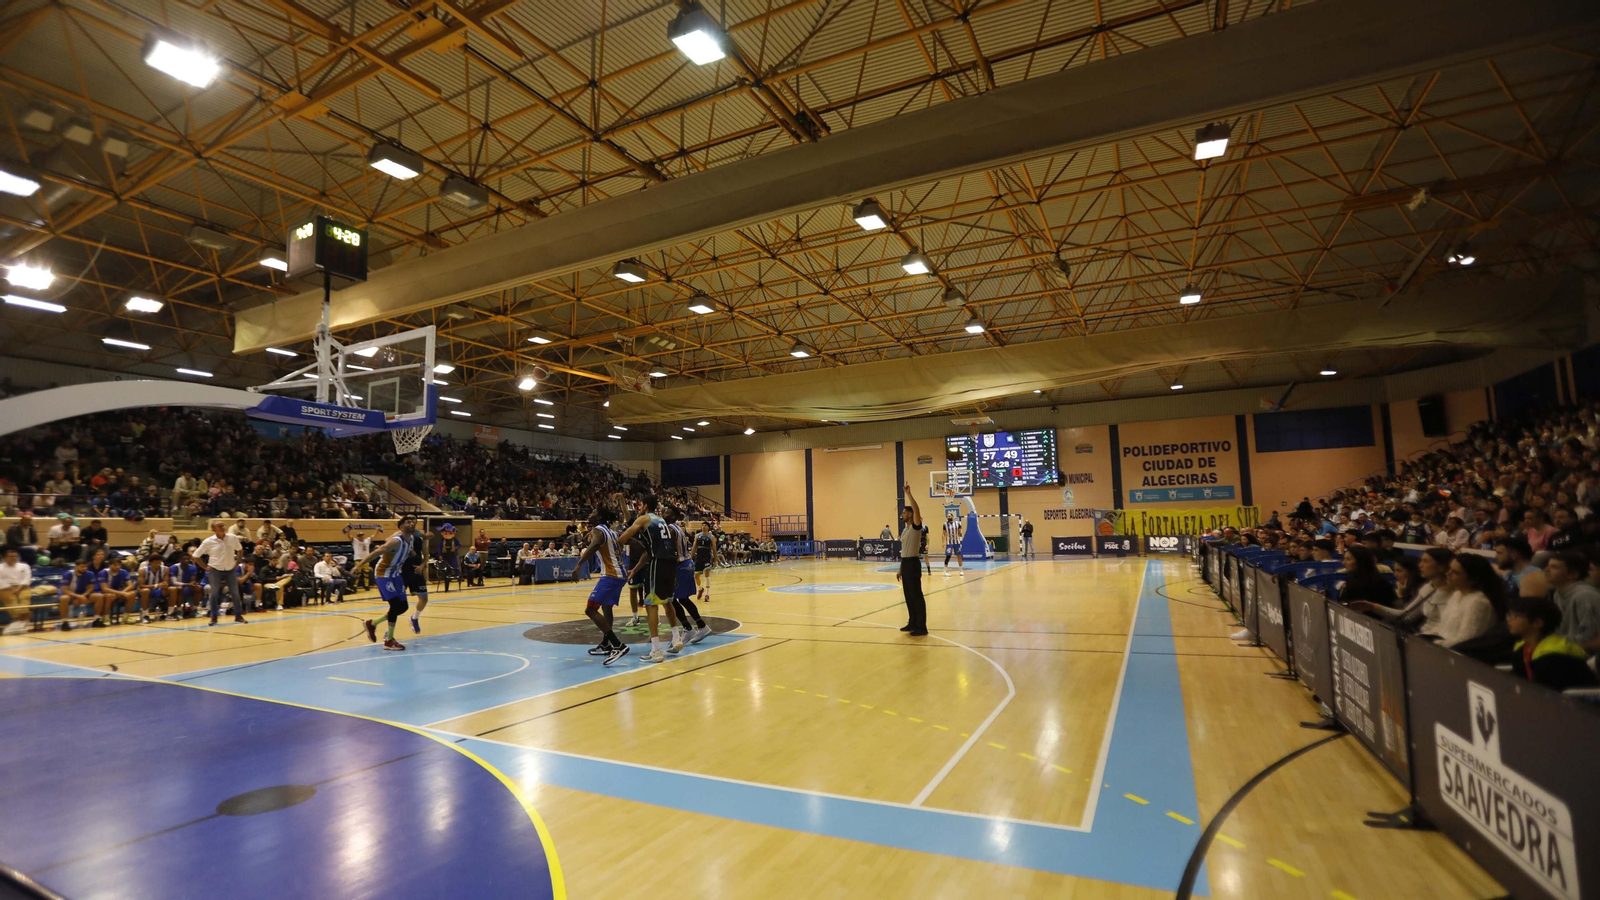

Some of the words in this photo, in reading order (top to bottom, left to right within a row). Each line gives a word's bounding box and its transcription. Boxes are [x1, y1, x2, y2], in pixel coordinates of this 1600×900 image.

[301, 406, 331, 416] SPORT
[331, 410, 366, 420] SYSTEM
[983, 451, 996, 461] 57
[1004, 450, 1018, 459] 49
[1123, 440, 1232, 457] POLIDEPORTIVO
[1142, 458, 1194, 472] CIUDAD
[1198, 457, 1217, 468] DE
[1068, 473, 1094, 485] MUNICIPAL
[1142, 472, 1218, 487] ALGECIRAS
[1044, 509, 1067, 520] DEPORTES
[1070, 508, 1094, 519] ALGECIRAS
[1123, 511, 1138, 536] LA
[1141, 511, 1205, 536] FORTALEZA
[658, 523, 672, 540] 21
[1149, 537, 1179, 547] NOP
[1441, 734, 1558, 827] SUPERMERCADOS
[1443, 754, 1568, 891] SAAVEDRA
